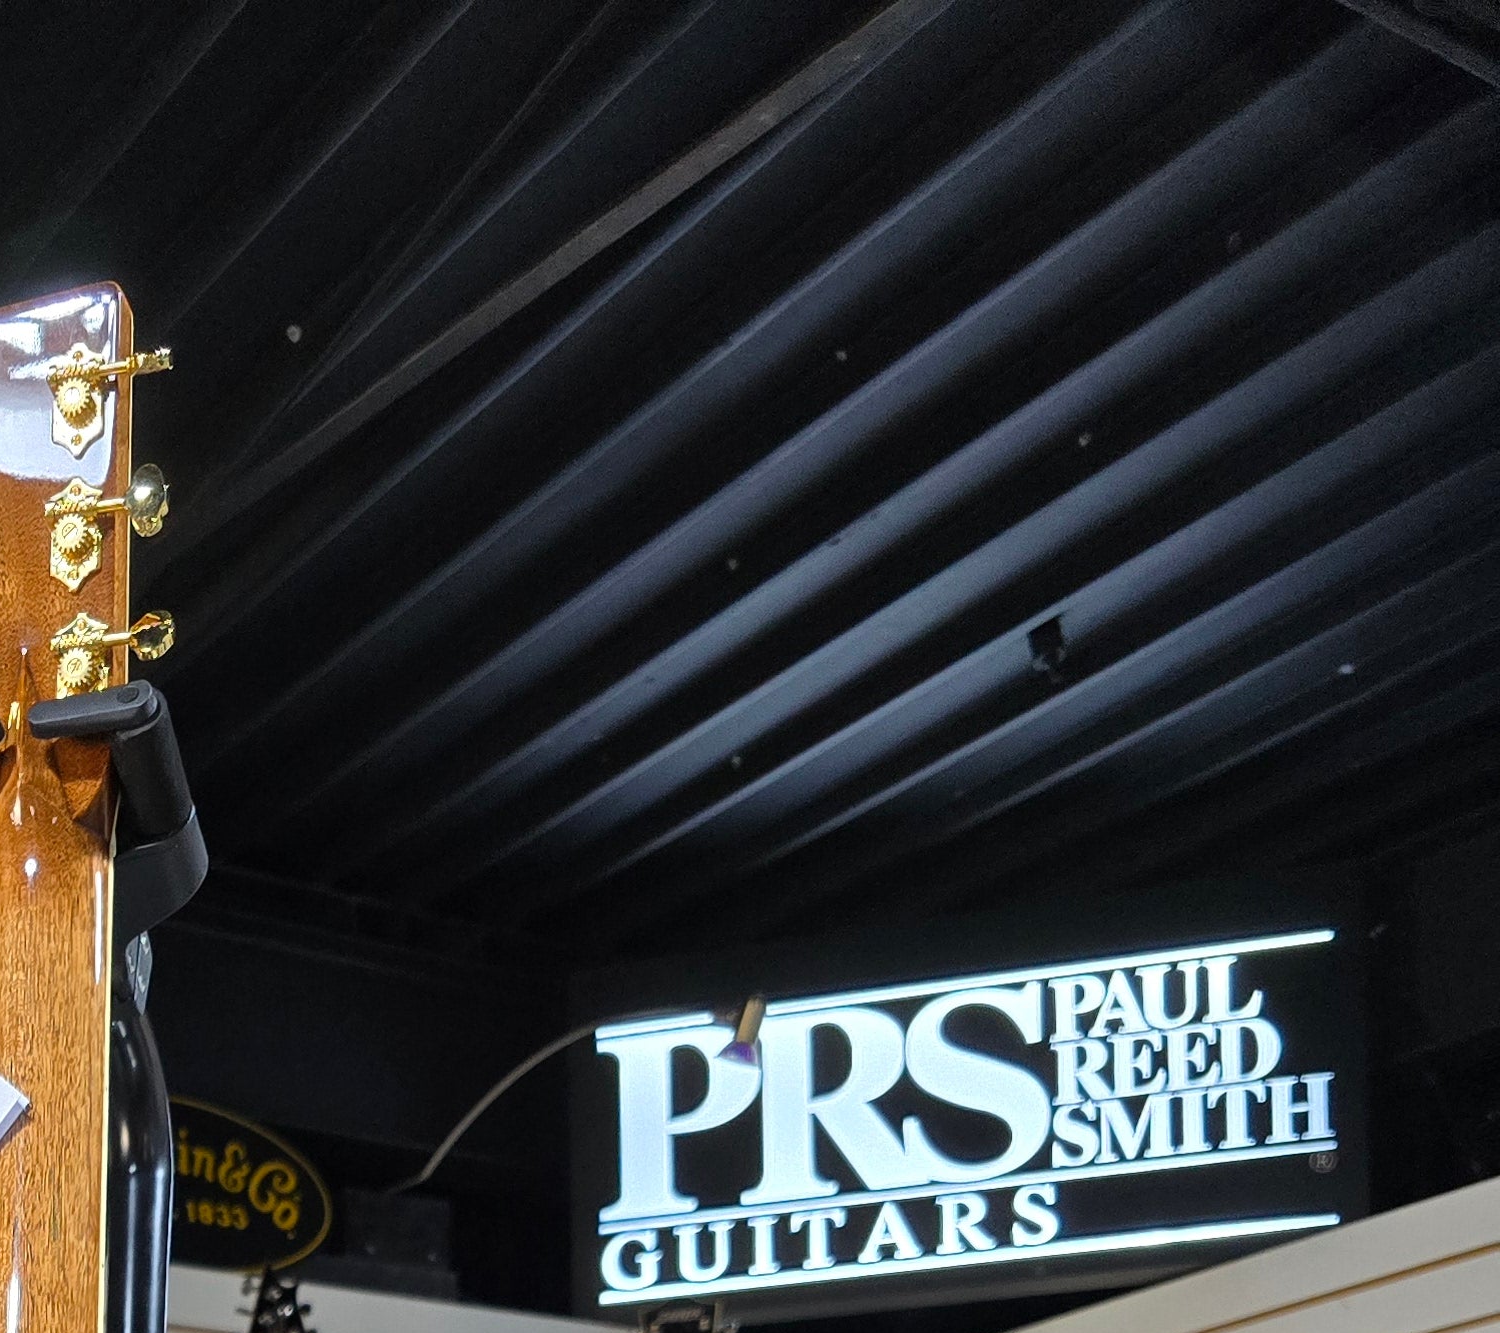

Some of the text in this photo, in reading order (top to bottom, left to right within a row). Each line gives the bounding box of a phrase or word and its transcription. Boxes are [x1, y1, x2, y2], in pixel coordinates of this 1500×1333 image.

[1048, 955, 1264, 1043] PAUL
[596, 979, 1052, 1223] PRS
[1051, 1018, 1282, 1107] REED
[1051, 1072, 1338, 1170] SMITH
[187, 1202, 249, 1230] 1833
[600, 1183, 1061, 1292] GUITARS
